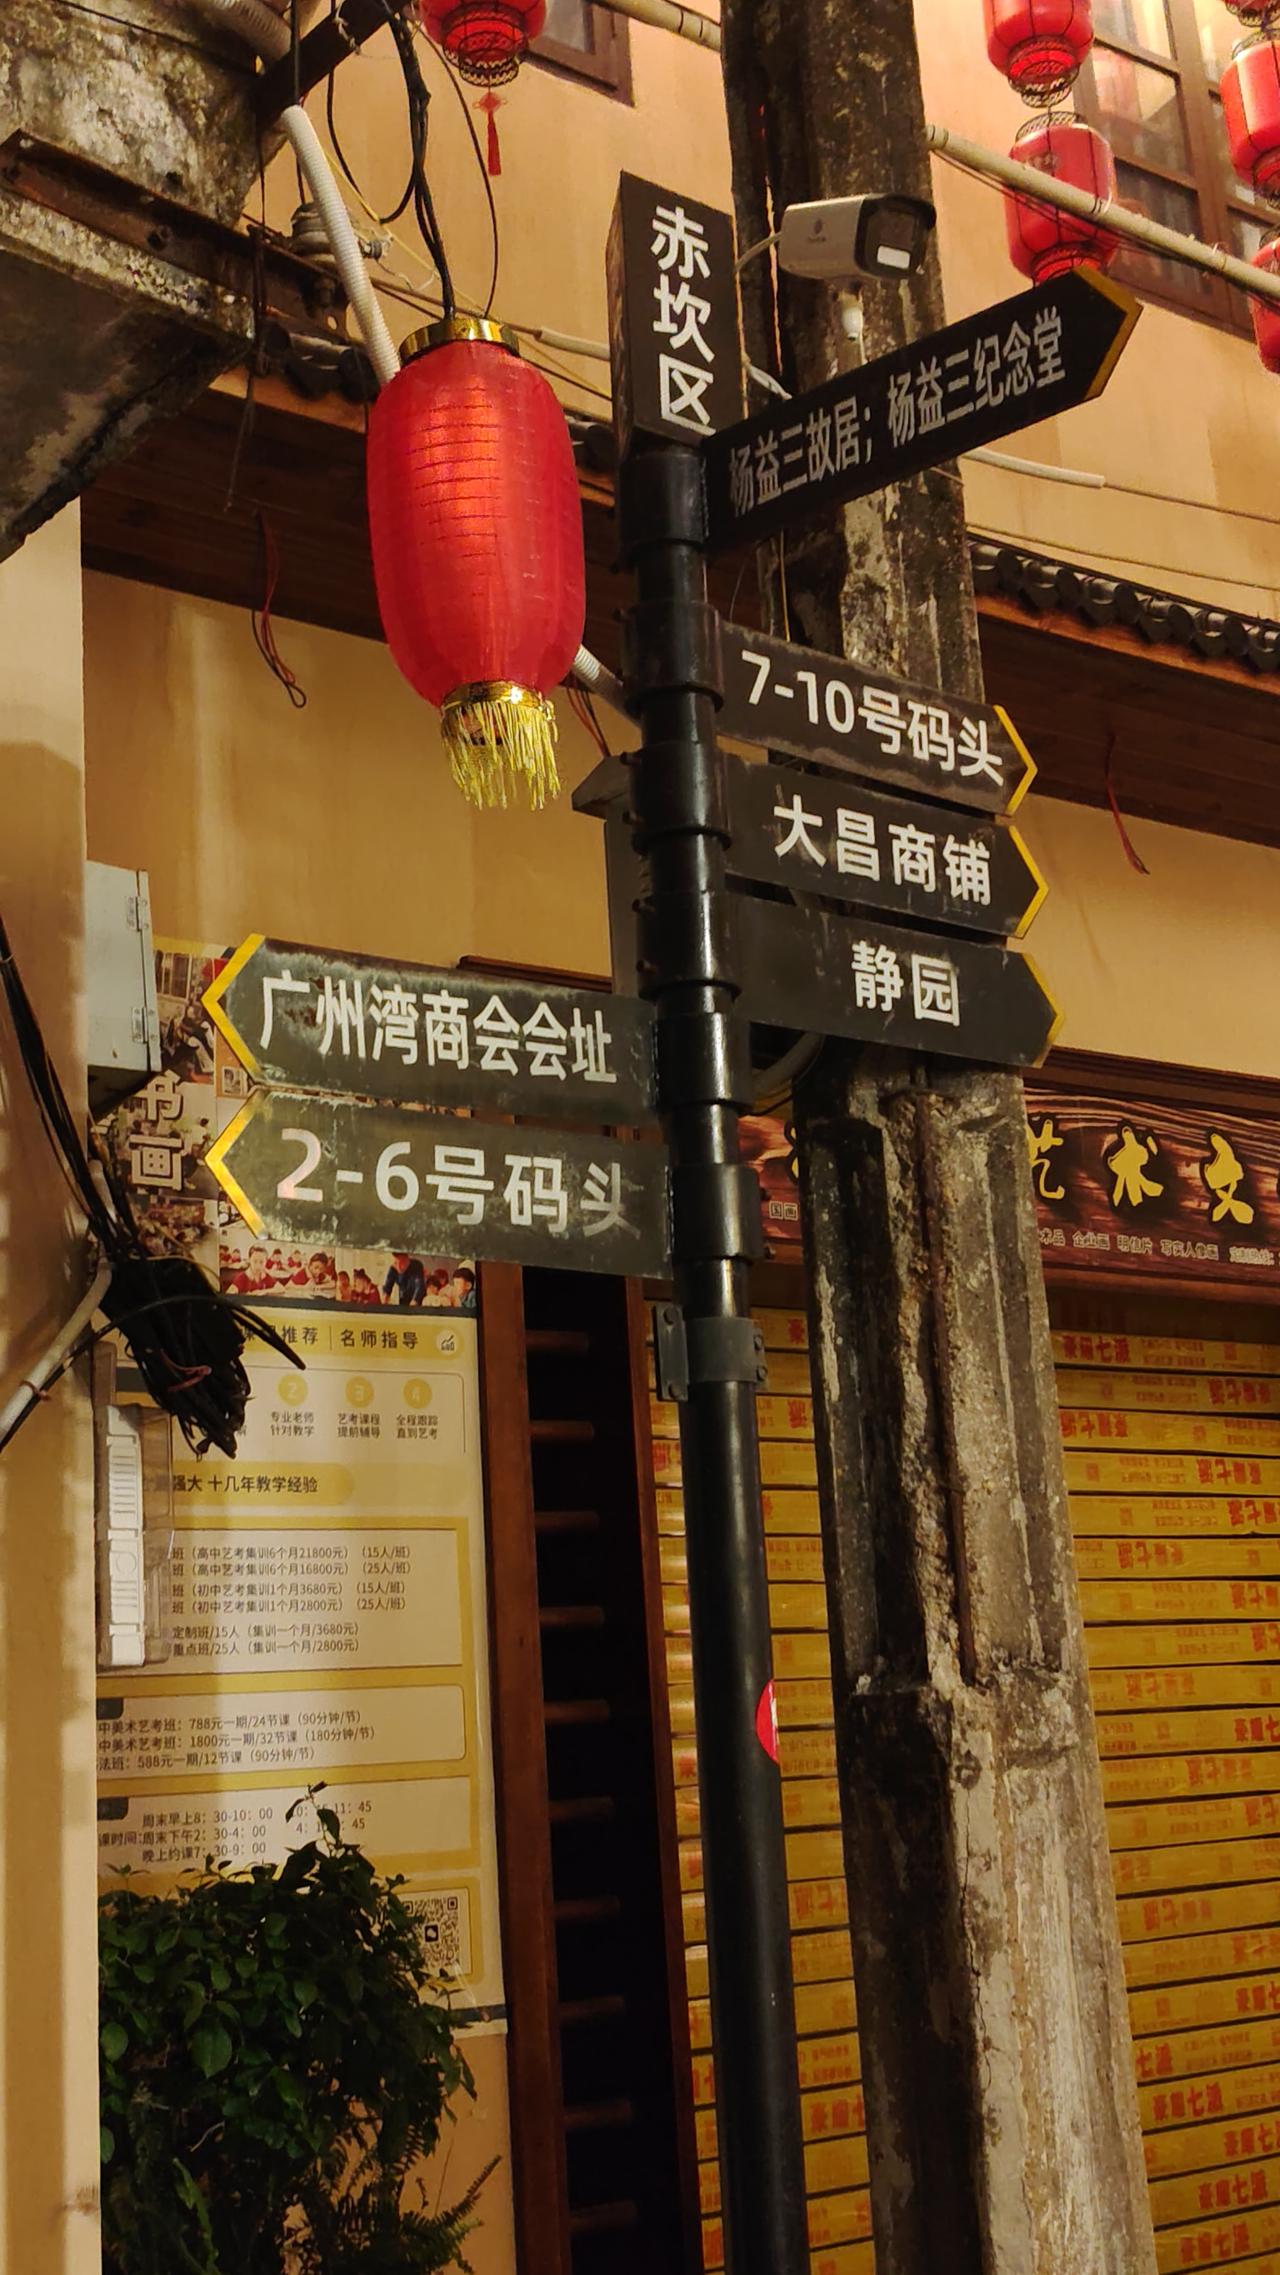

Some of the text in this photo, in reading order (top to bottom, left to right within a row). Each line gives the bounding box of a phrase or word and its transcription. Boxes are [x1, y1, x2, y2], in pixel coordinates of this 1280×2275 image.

[651, 205, 717, 437] 赤坎区
[741, 650, 1004, 787] 7-10号码头
[773, 794, 992, 906] 大昌商铺
[851, 941, 960, 1027] 静园
[260, 969, 618, 1084] 广州湾商会会址
[276, 1128, 644, 1239] 2-6号码头
[340, 1329, 419, 1349] 名师指导
[270, 1425, 315, 1438] 针对教学
[271, 1412, 315, 1424] 专业老师
[337, 1413, 381, 1426] 艺考课程
[337, 1426, 381, 1439] 提前辅导
[396, 1414, 438, 1426] 全程跟踪
